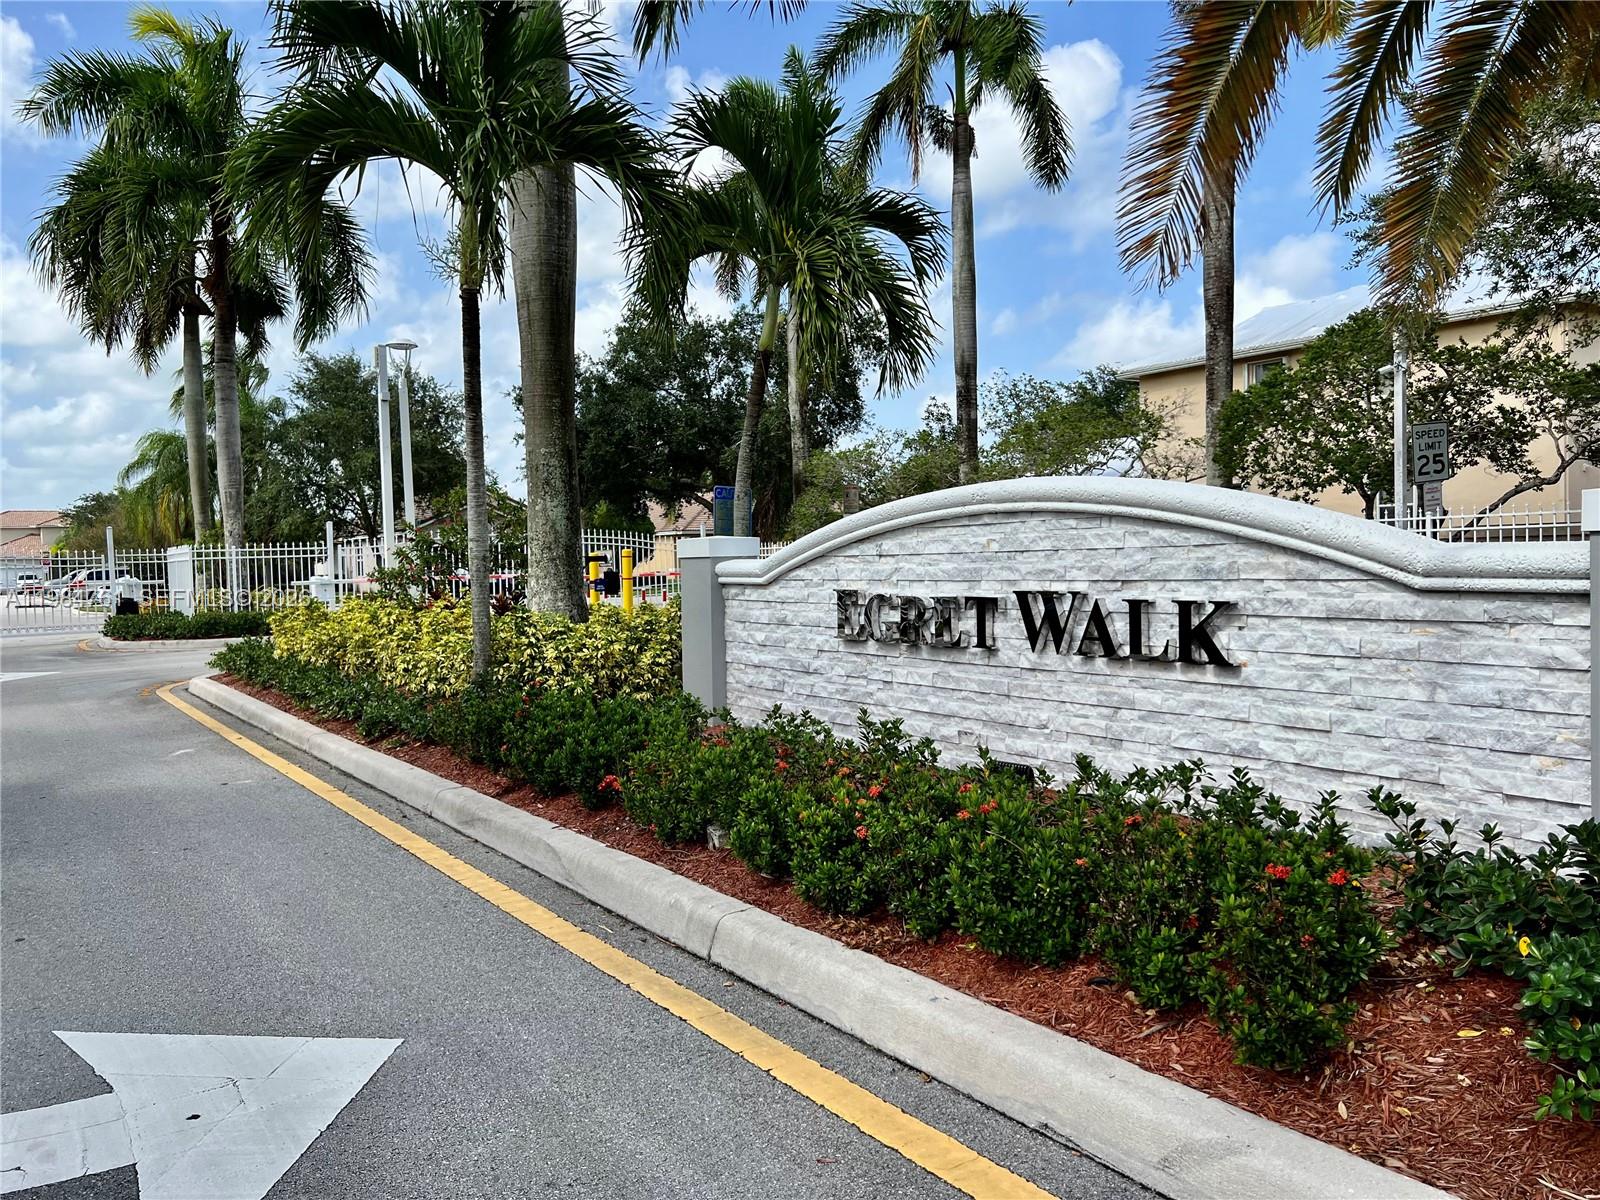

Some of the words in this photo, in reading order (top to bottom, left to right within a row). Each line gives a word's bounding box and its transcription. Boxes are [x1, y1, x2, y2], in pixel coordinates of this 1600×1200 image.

[1415, 428, 1446, 440] SPEED
[1418, 441, 1442, 451] LIMIT
[1417, 453, 1446, 475] 25
[833, 588, 1000, 650] EGRET
[1013, 590, 1240, 668] WALK
